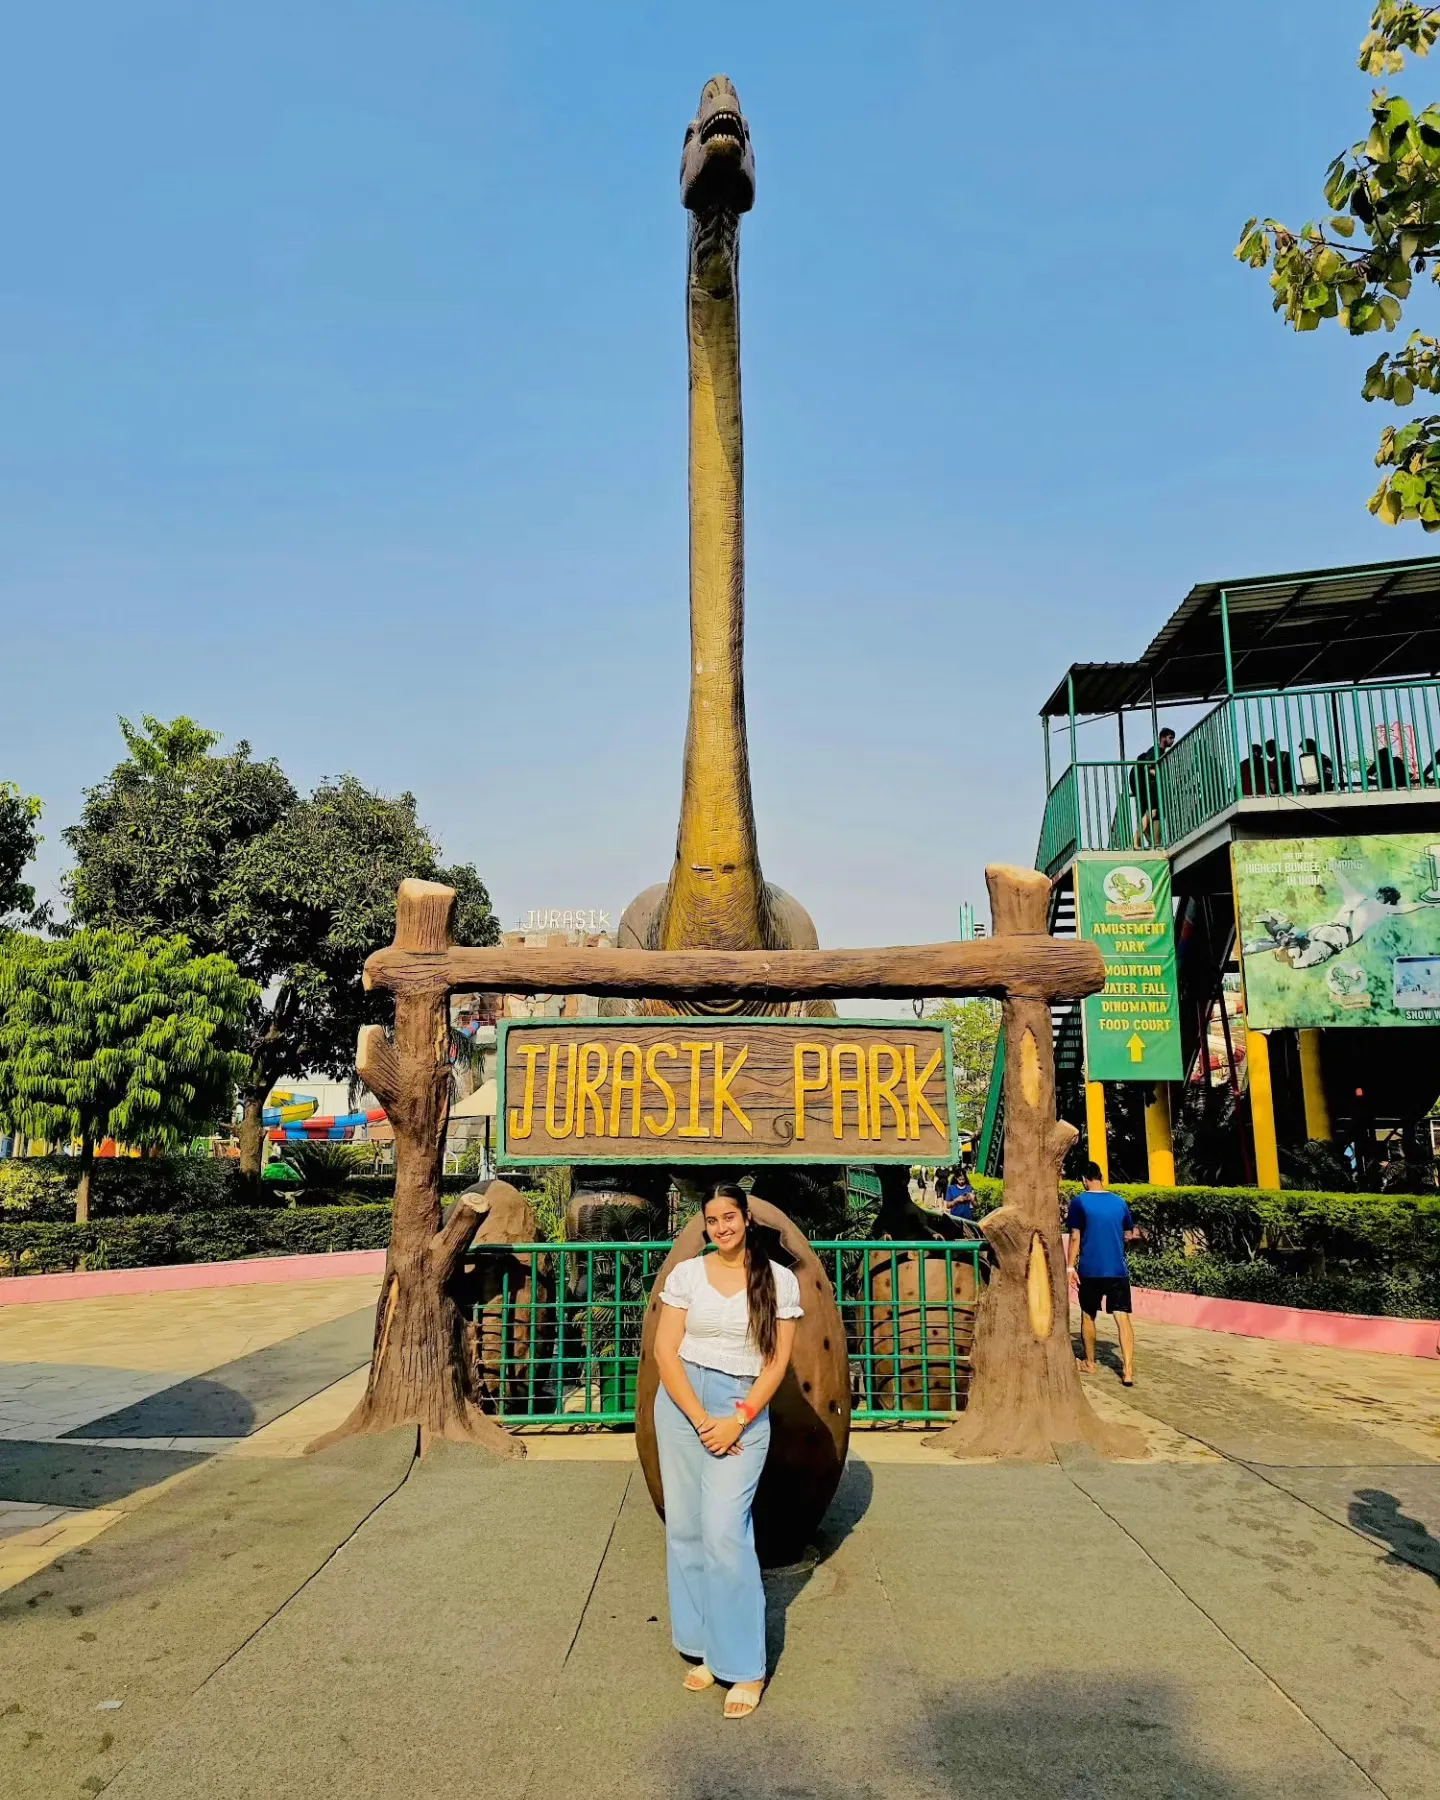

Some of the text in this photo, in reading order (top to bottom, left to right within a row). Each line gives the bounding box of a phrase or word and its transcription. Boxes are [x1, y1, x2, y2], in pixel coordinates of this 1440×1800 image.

[1245, 863, 1282, 874] HIGHEST
[1285, 862, 1321, 873] BUNGEE
[523, 908, 611, 930] JURASIK
[1093, 923, 1166, 935] AMUSEMENT
[1115, 940, 1145, 952] PARK
[1105, 964, 1162, 976] MOUNTAIN
[1142, 982, 1168, 994] FALL
[1102, 1001, 1168, 1013] DINOMANIA
[1405, 1010, 1431, 1020] SNOW
[1099, 1018, 1171, 1031] FOOD COURT
[509, 1041, 947, 1141] JURASIK PARK
